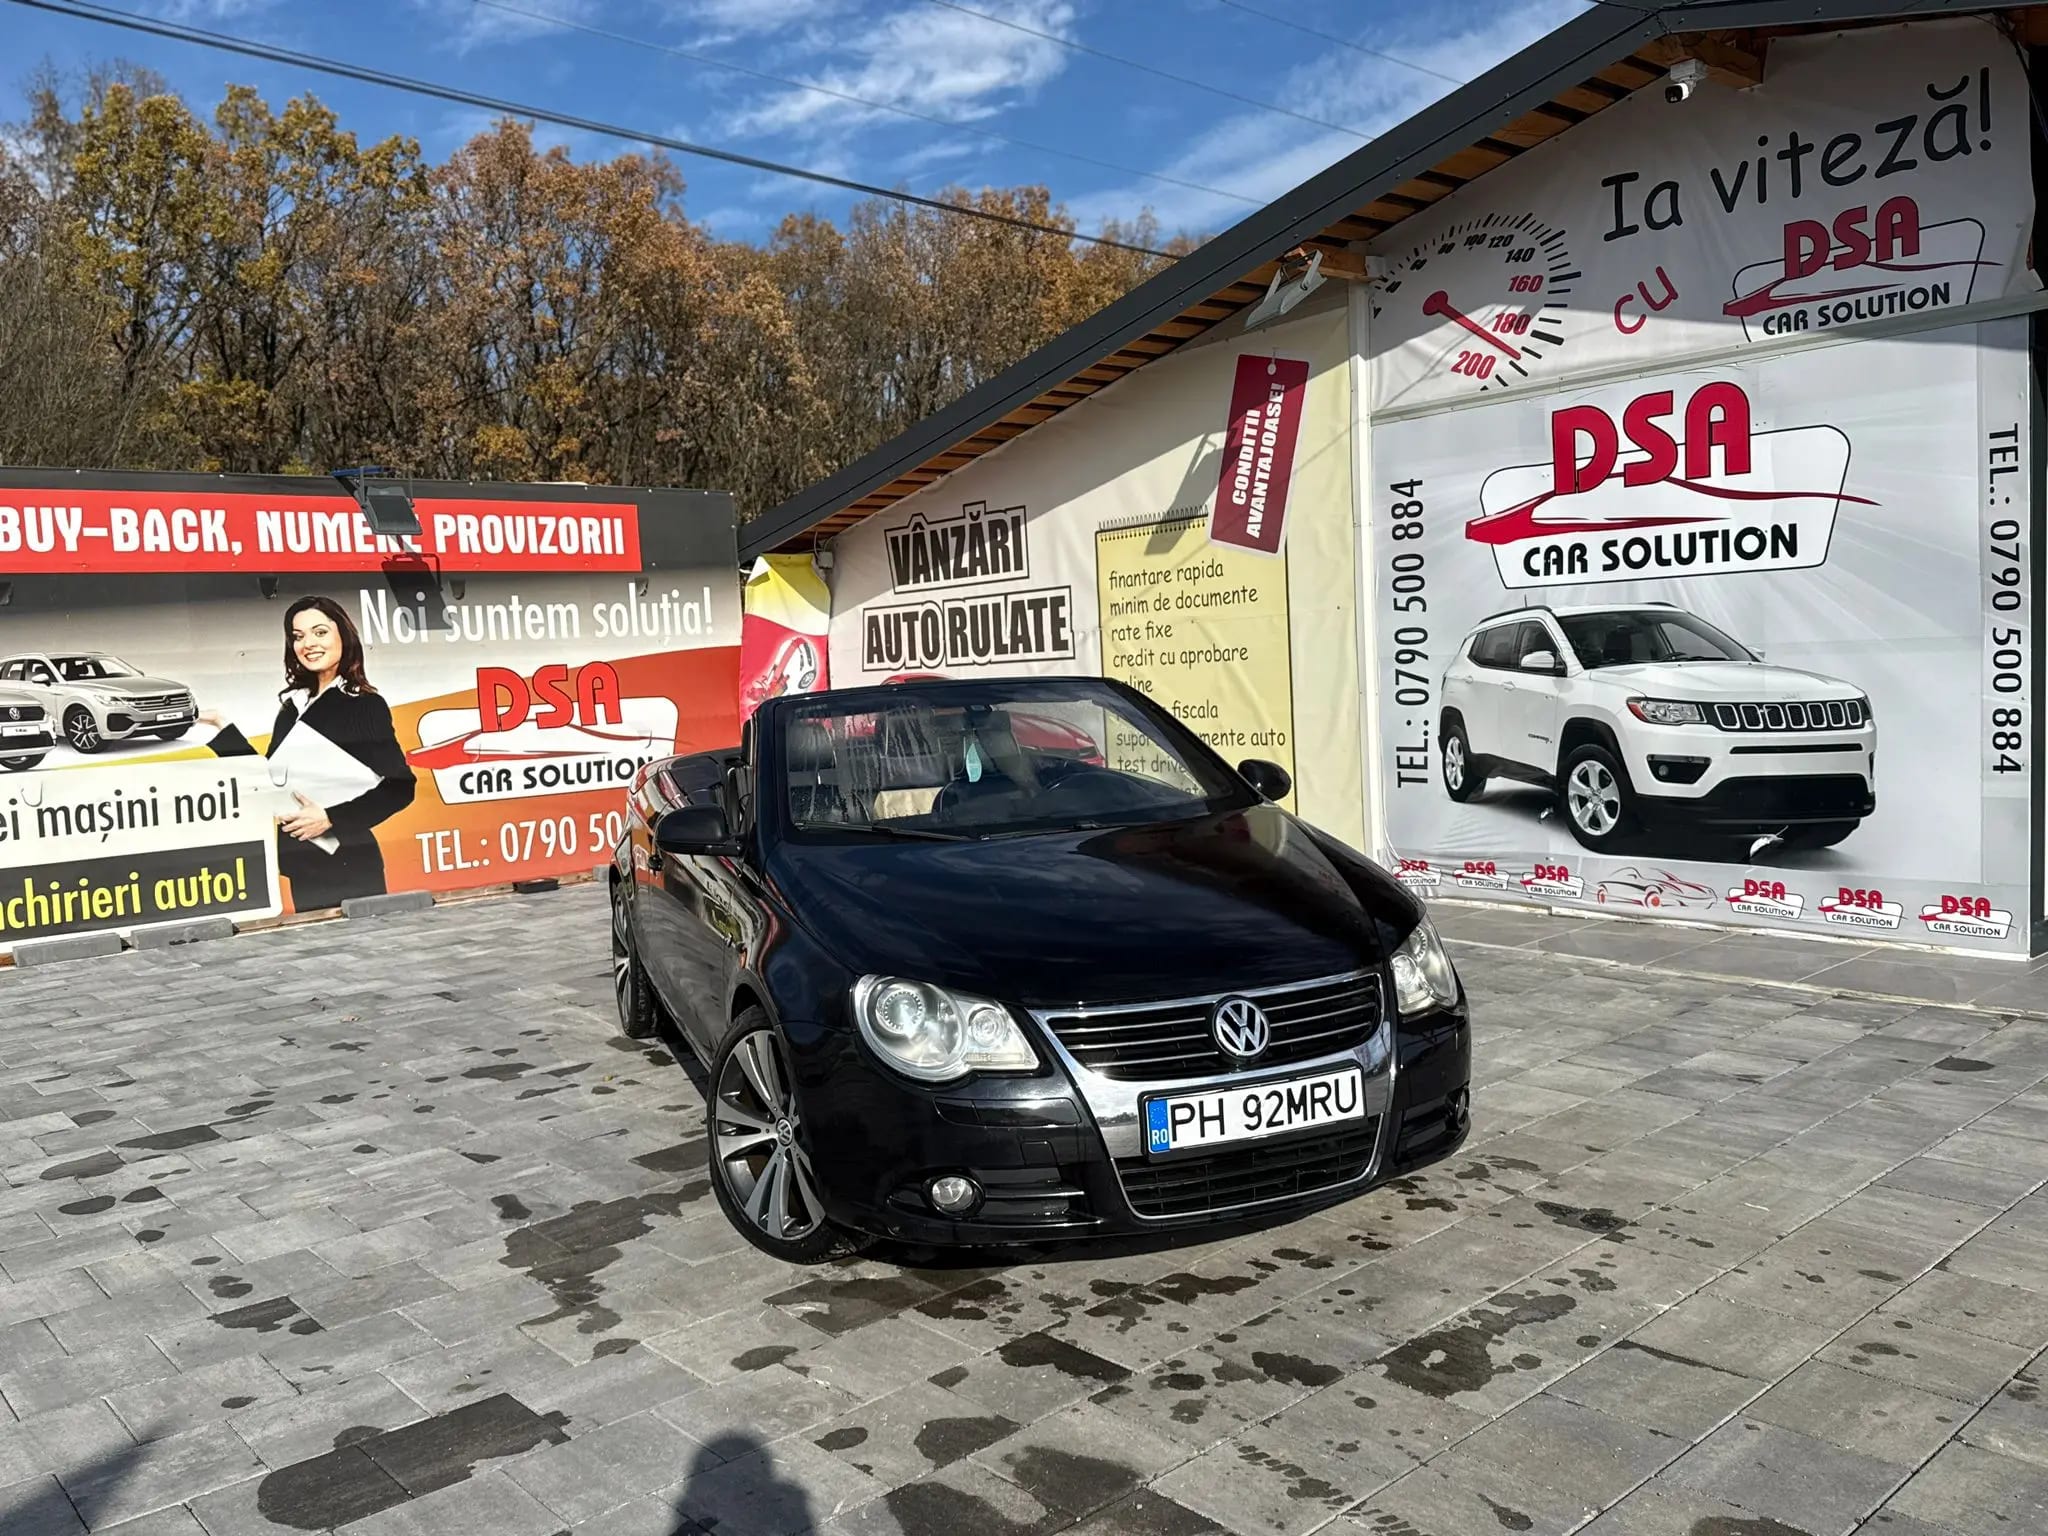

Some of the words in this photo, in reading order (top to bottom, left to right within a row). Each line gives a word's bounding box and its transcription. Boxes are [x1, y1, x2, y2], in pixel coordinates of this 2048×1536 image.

[1602, 171, 1683, 242] Ia
[1710, 67, 1992, 213] viteză!
[1464, 233, 1487, 246] 100
[1488, 234, 1514, 248] 120
[1505, 247, 1536, 263] 140
[1783, 195, 1920, 281] DSA
[1508, 275, 1544, 293] 160
[1614, 266, 1679, 335] cu
[1492, 313, 1532, 335] 180
[1763, 308, 1809, 337] CAR
[1818, 281, 1951, 327] SOLUTION
[1450, 350, 1496, 380] 200
[1232, 409, 1261, 505] CONDITII
[1552, 381, 1752, 496] DSA
[1246, 383, 1285, 539] AVANTAJOASE!
[1989, 423, 2019, 505] TEL.:
[1390, 479, 1424, 540] 884
[434, 512, 625, 555] PROVIZORII
[891, 510, 1024, 587] VÂNZĂRI
[1523, 543, 1588, 577] CAR
[1602, 523, 1798, 573] SOLUTION
[1109, 568, 1172, 590] finantare
[1177, 558, 1224, 586] rapida
[1392, 553, 1427, 612] 500
[1990, 519, 2021, 611] 0790
[360, 589, 427, 644] Noi
[442, 595, 581, 643] suntem
[1110, 596, 1149, 616] minim
[1153, 593, 1171, 612] de
[1176, 585, 1258, 609] documente
[866, 604, 940, 664] AUTO
[944, 595, 1069, 659] RULATE
[1111, 624, 1140, 642] rate
[1146, 620, 1173, 640] fixe
[1113, 648, 1155, 668] credit
[1160, 651, 1176, 665] cu
[1180, 644, 1249, 669] aprobare
[1394, 627, 1430, 706] 0790
[1992, 627, 2023, 693] 500
[476, 661, 623, 733] DSA
[1172, 699, 1219, 719] fiscala
[1251, 728, 1286, 747] auto
[1396, 719, 1430, 788] TEL.:
[1992, 708, 2023, 774] 884
[459, 768, 513, 795] CAR
[1119, 754, 1147, 772] test
[174, 777, 241, 824] noi!
[415, 829, 490, 874] TEL.:
[500, 815, 577, 863] 0790
[154, 857, 248, 908] auto!
[1463, 861, 1496, 875] DSA
[1534, 864, 1569, 881] DSA
[1744, 879, 1786, 900] DSA
[1530, 886, 1543, 894] CAR
[1544, 886, 1578, 897] SOLUTION
[1737, 904, 1752, 912] CAR
[1753, 905, 1794, 917] SOLUTION
[1839, 887, 1883, 909] DSA
[1941, 895, 1990, 918] DSA
[1831, 913, 1847, 922] CAR
[1849, 914, 1893, 927] SOLUTION
[1934, 922, 1951, 931] CAR
[1953, 923, 2001, 937] SOLUTION
[1170, 1098, 1225, 1142] PH
[1243, 1075, 1357, 1131] 92MRU
[1152, 1129, 1168, 1146] RO
